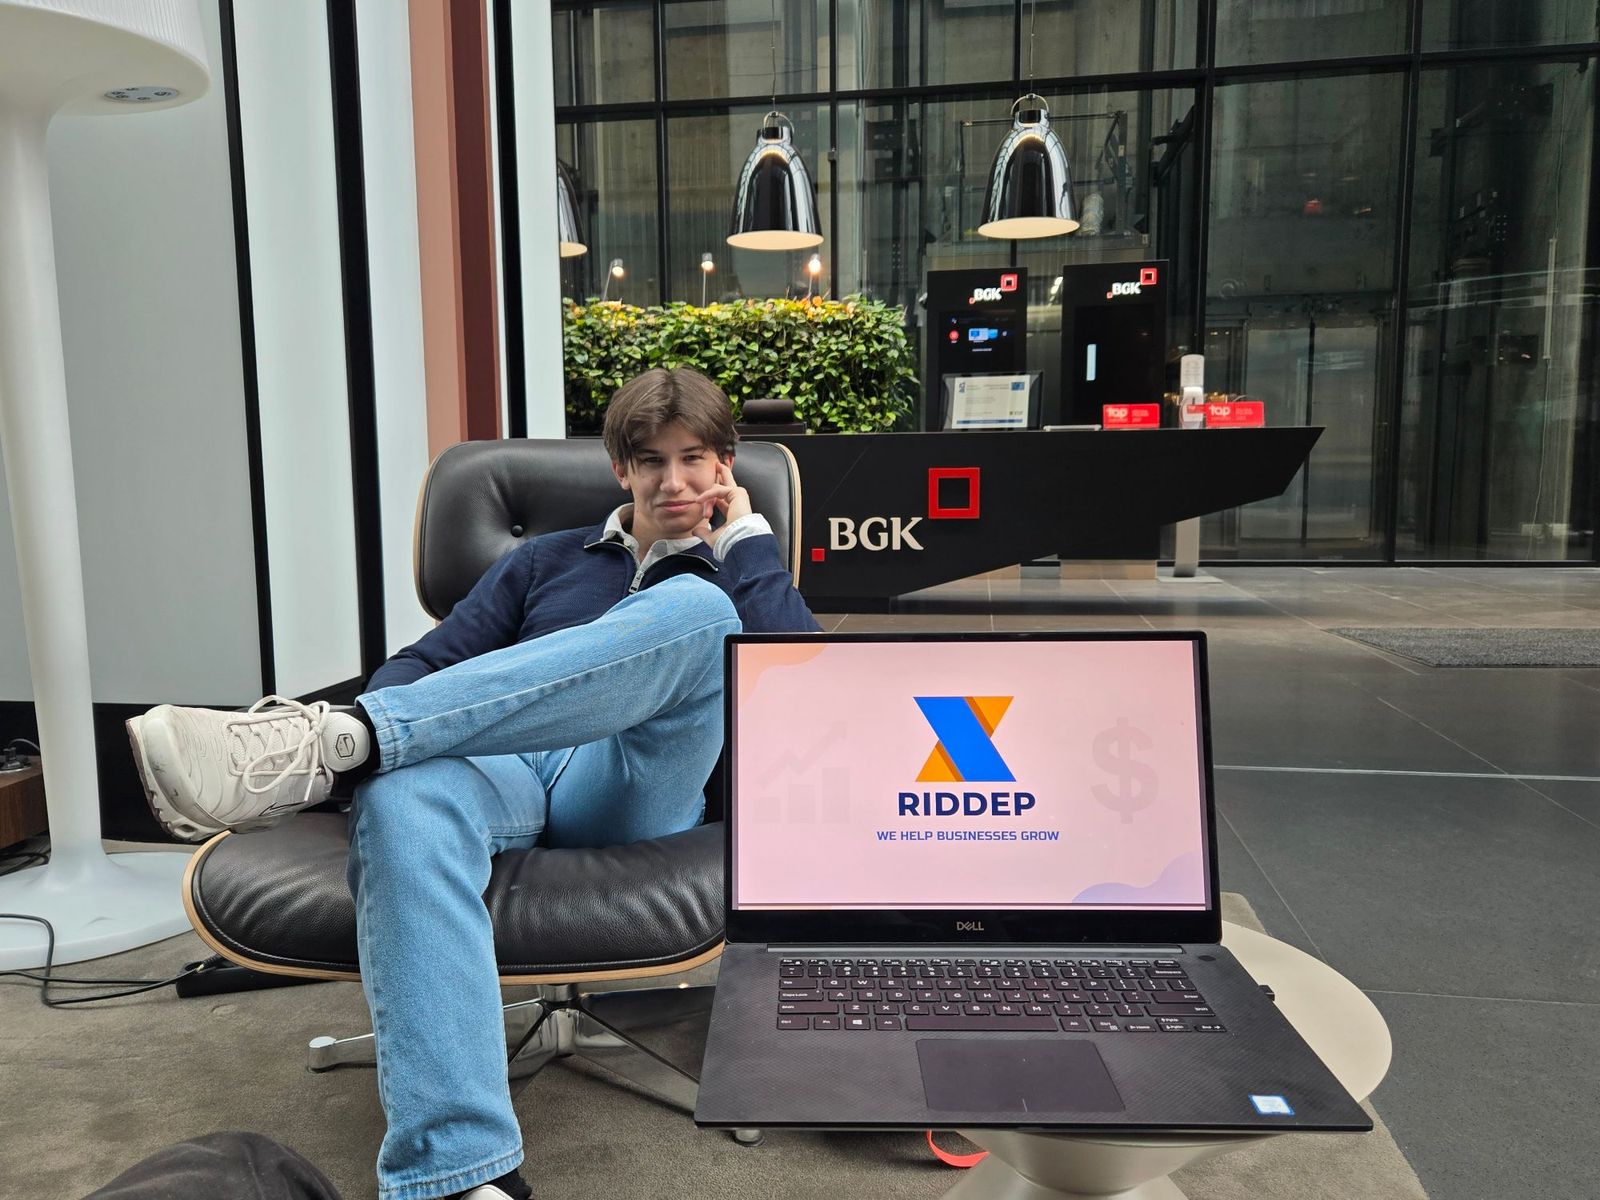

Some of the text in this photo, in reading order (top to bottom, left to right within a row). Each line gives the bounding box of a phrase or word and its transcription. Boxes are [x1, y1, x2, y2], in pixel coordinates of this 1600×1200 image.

[973, 288, 1002, 301] BGK
[1111, 282, 1142, 296] BGK
[828, 516, 925, 551] BGK
[898, 791, 1036, 817] RIDDEP
[876, 830, 1060, 841] WE HELP BUSINESSES GROW
[956, 921, 985, 931] DELL
